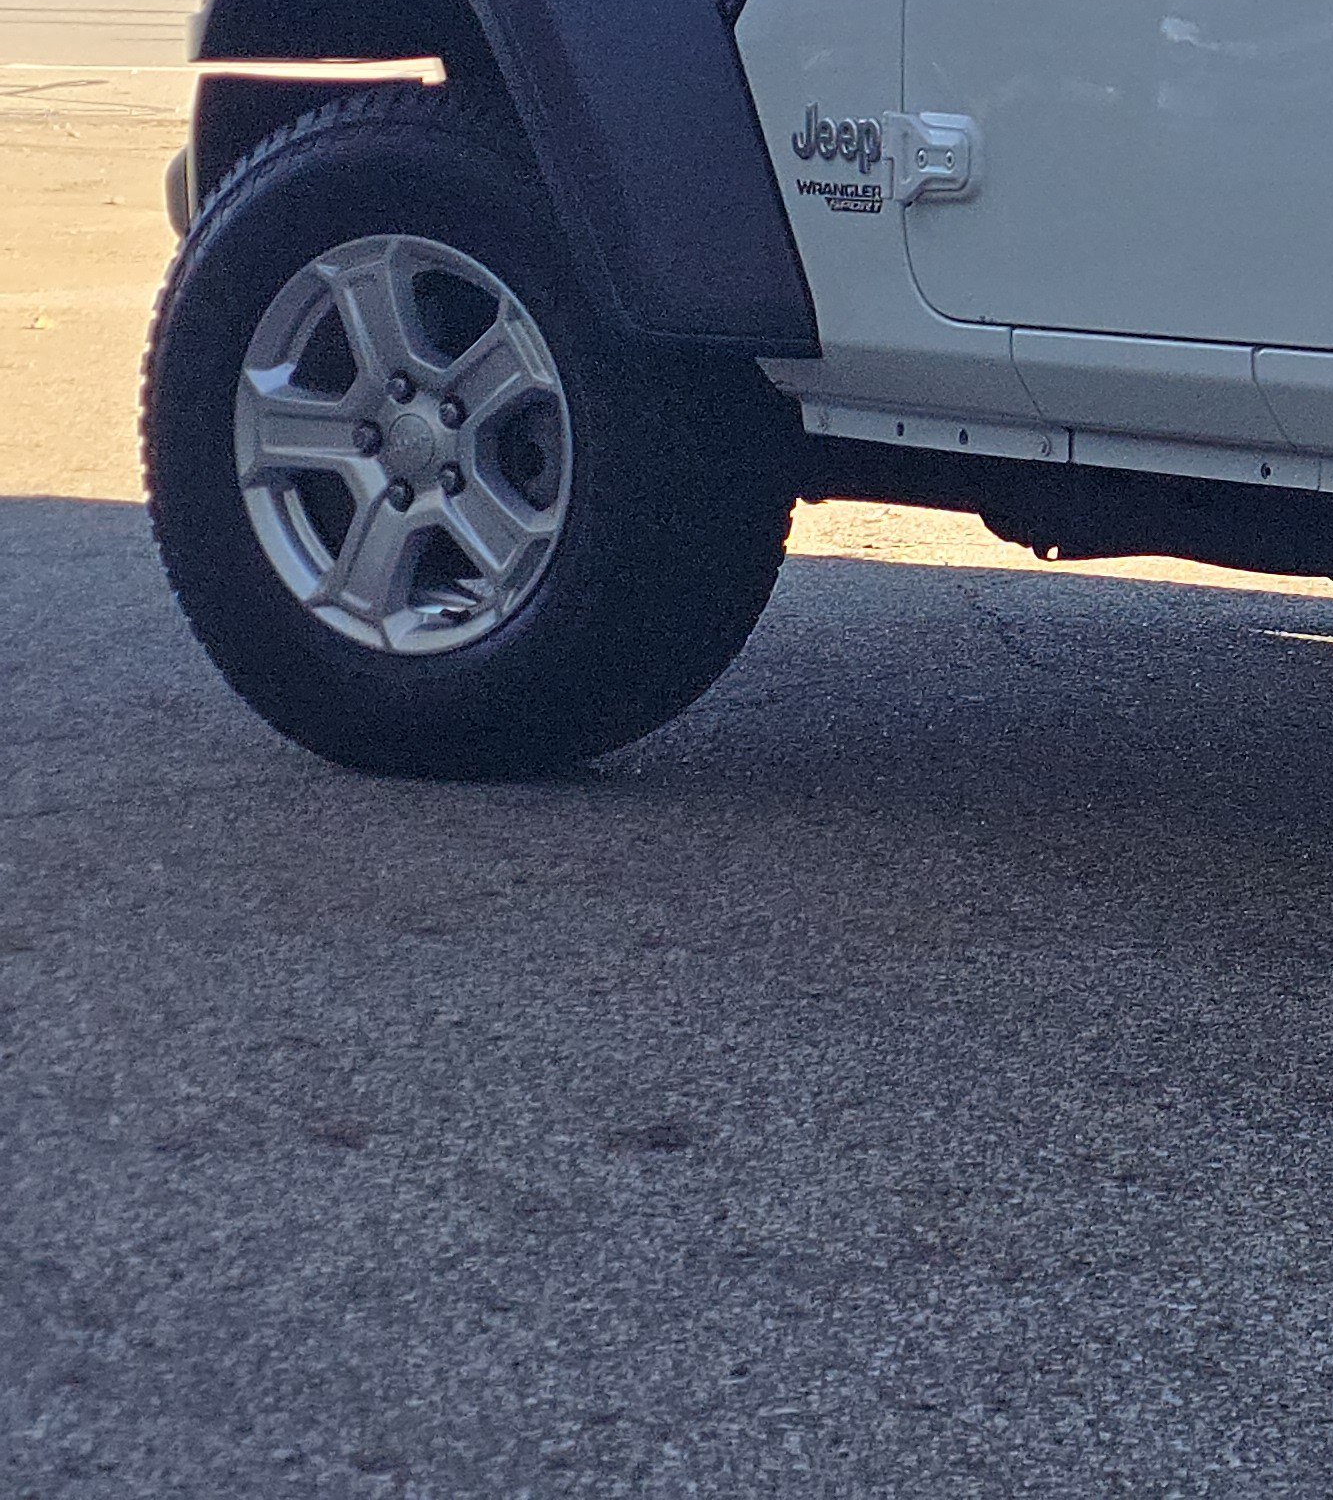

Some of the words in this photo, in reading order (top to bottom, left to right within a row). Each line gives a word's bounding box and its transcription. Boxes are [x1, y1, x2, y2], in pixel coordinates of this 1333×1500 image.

[791, 101, 883, 174] Jeep
[797, 179, 882, 197] WRANGLER
[829, 199, 883, 212] SPORT
